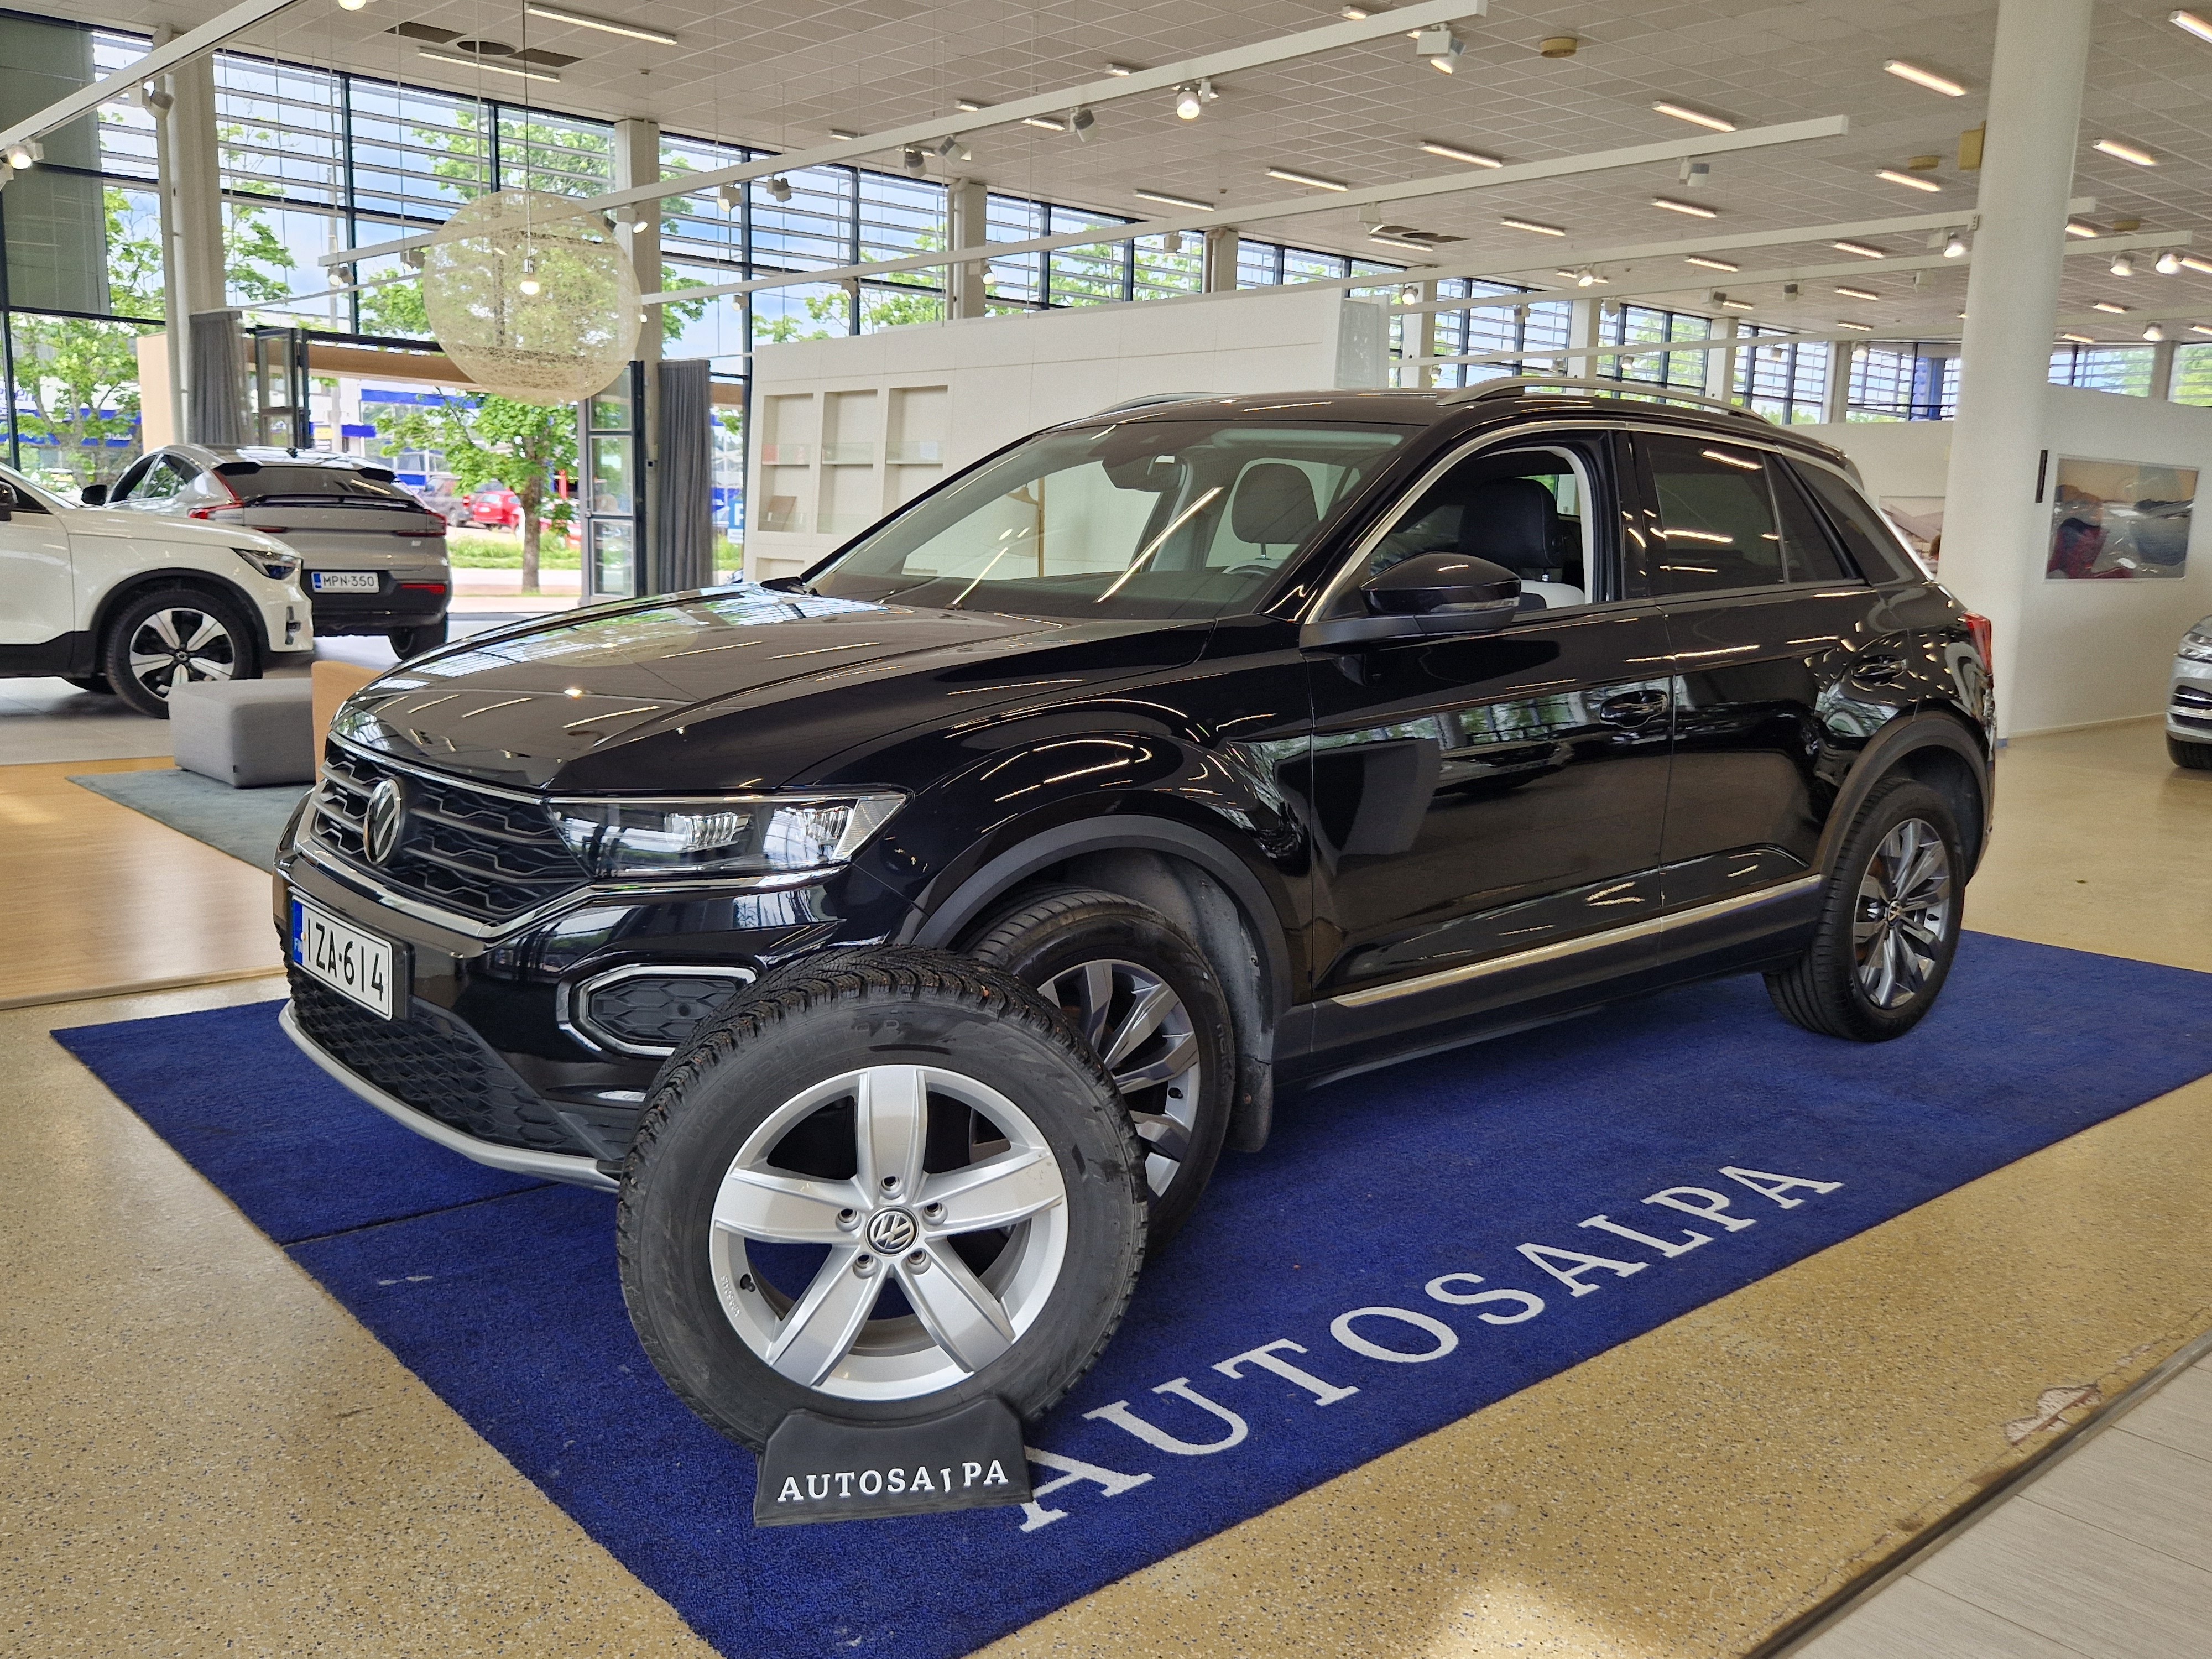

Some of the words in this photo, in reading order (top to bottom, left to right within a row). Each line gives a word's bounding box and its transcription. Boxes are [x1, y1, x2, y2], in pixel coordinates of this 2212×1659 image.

[322, 576, 374, 587] MPN-350
[307, 916, 384, 1002] IZA-614
[1019, 1165, 1844, 1532] AUTOSALPA
